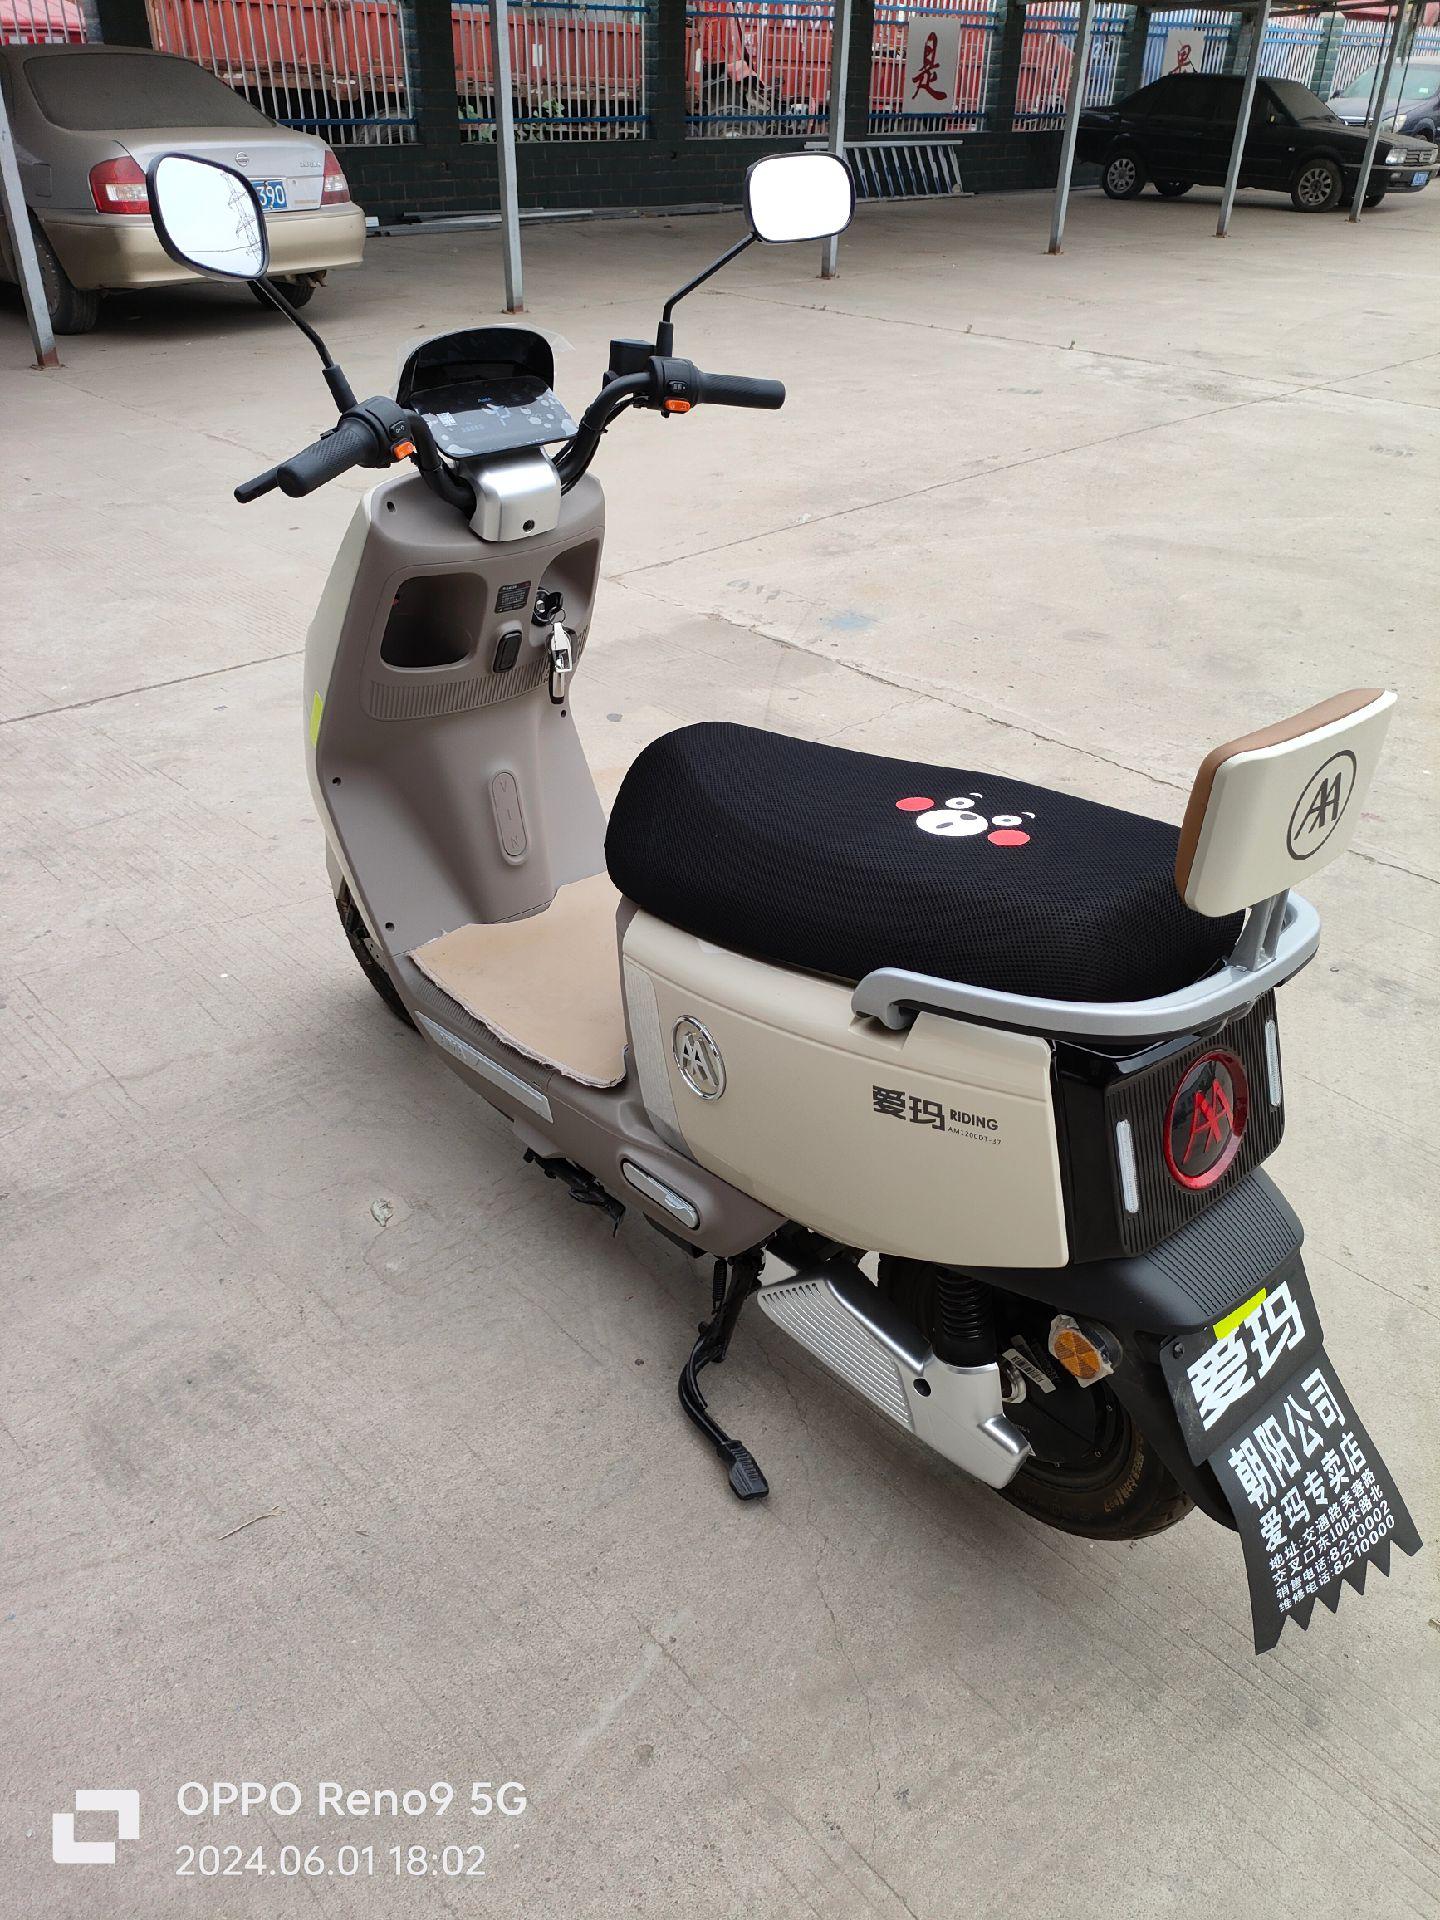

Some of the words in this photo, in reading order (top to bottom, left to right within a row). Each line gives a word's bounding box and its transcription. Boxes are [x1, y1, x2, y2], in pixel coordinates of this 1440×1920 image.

[256, 185, 285, 206] 390
[872, 1084, 946, 1132] 爱玛
[950, 1108, 999, 1131] RIDING
[1187, 1280, 1306, 1431] 爱玛
[1227, 1367, 1346, 1511] 朝阳公司
[1259, 1431, 1367, 1553] 爱玛专卖店
[1272, 1484, 1384, 1587] 交叉口东100米路北
